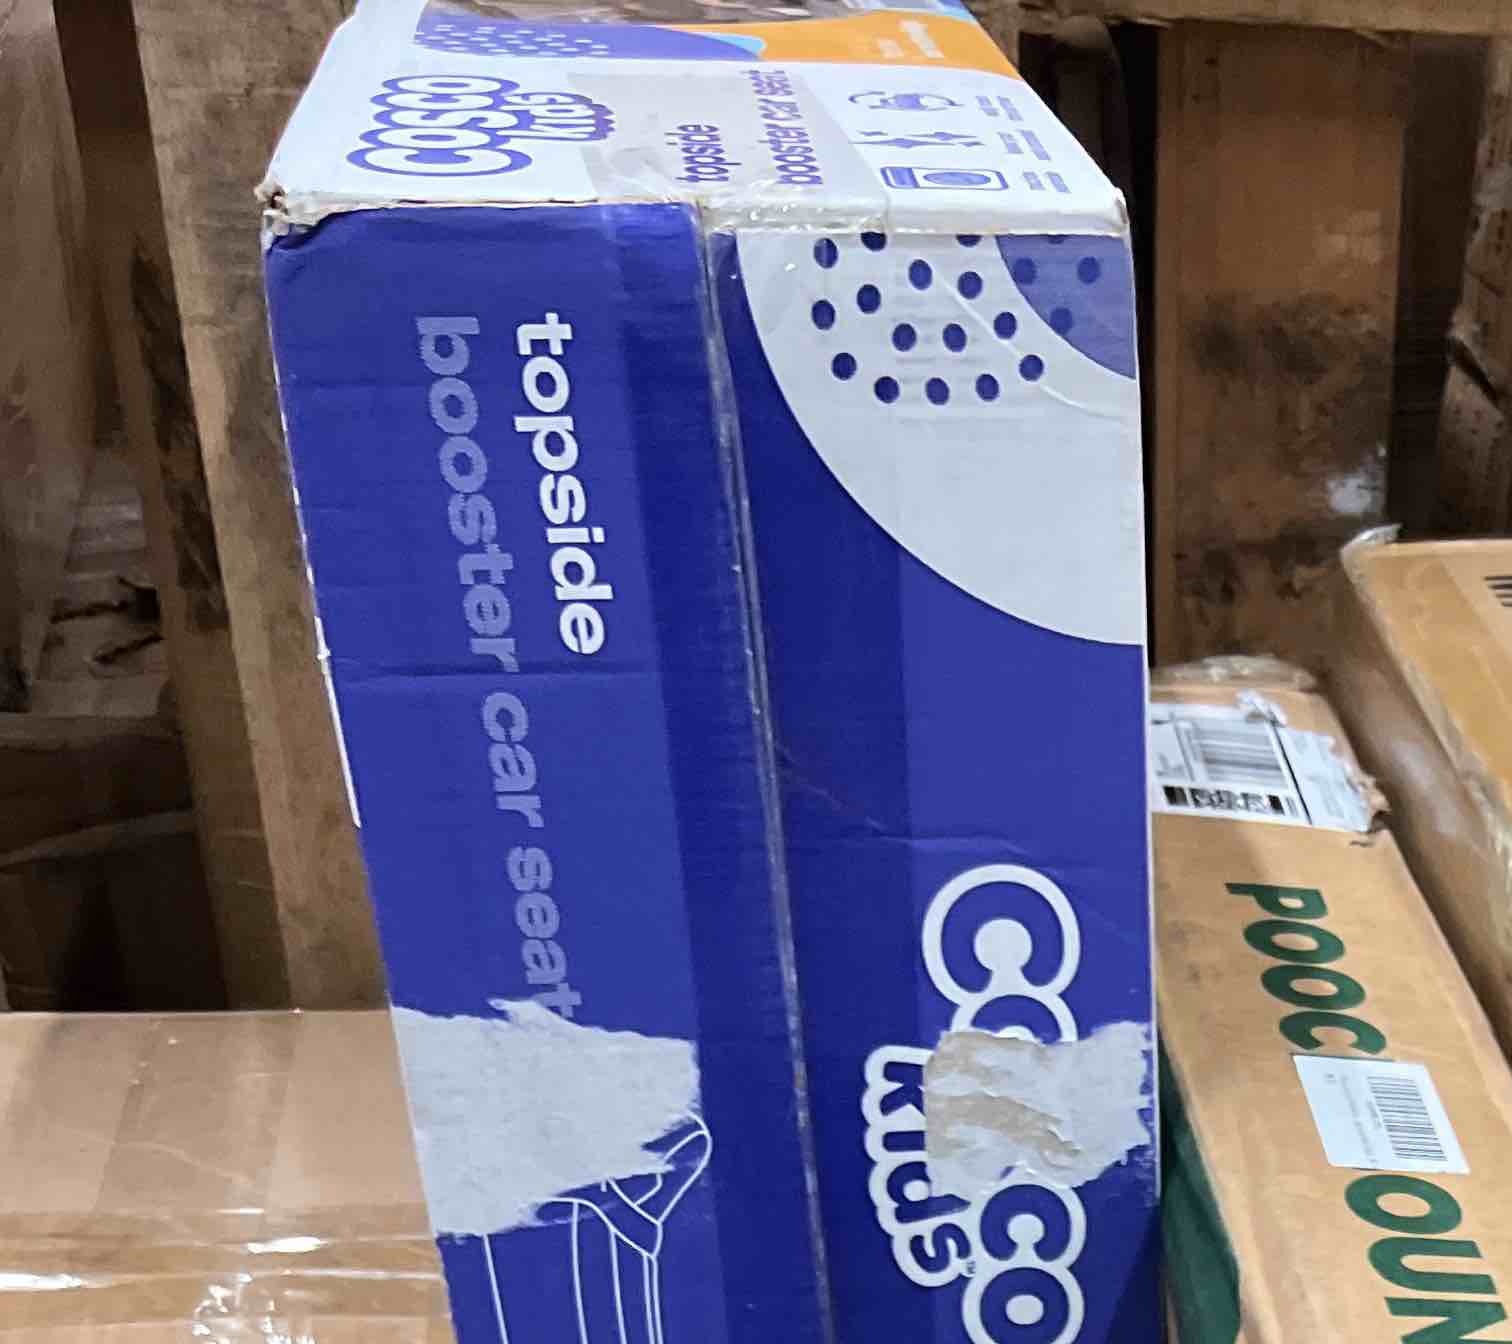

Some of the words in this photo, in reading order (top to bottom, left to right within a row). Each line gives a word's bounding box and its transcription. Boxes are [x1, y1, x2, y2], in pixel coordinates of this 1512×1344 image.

[346, 75, 533, 176] Cosco
[740, 69, 796, 96] seat
[757, 98, 803, 121] car
[664, 124, 742, 183] topside
[757, 124, 824, 184] booster
[415, 316, 519, 673] booster
[514, 312, 614, 656] topside
[481, 691, 545, 830] car
[507, 845, 583, 1019] seat
